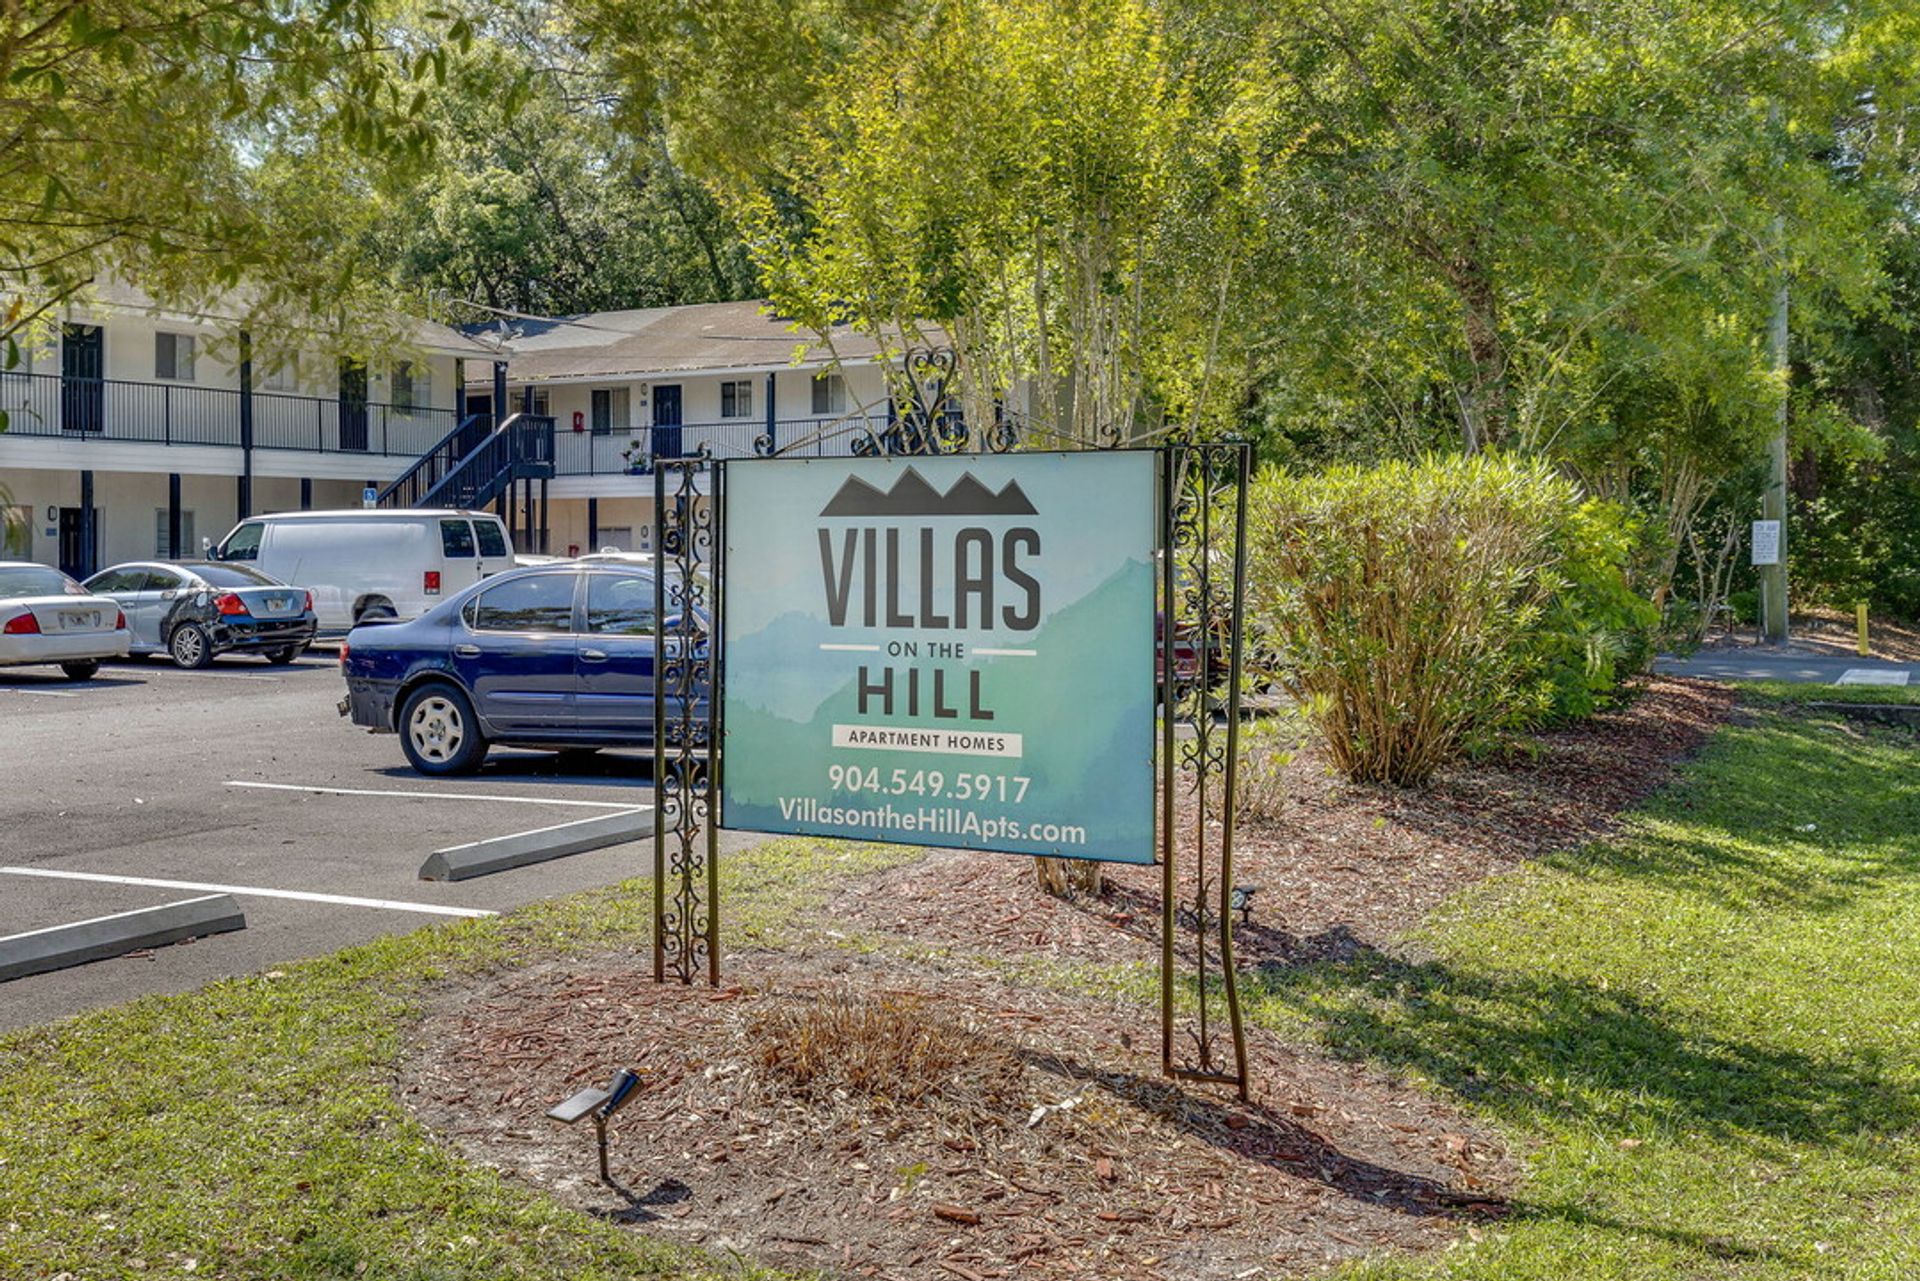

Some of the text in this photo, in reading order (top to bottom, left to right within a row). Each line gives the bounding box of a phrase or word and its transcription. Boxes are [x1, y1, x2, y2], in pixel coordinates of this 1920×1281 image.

[818, 527, 1041, 631] VILLAS
[887, 641, 964, 659] ON THE
[857, 666, 995, 721] HILL
[848, 730, 1006, 752] APARTMENT HOMES
[828, 765, 1031, 803] 904.549.5917
[779, 796, 1086, 844] VillasontheHillApts.com
